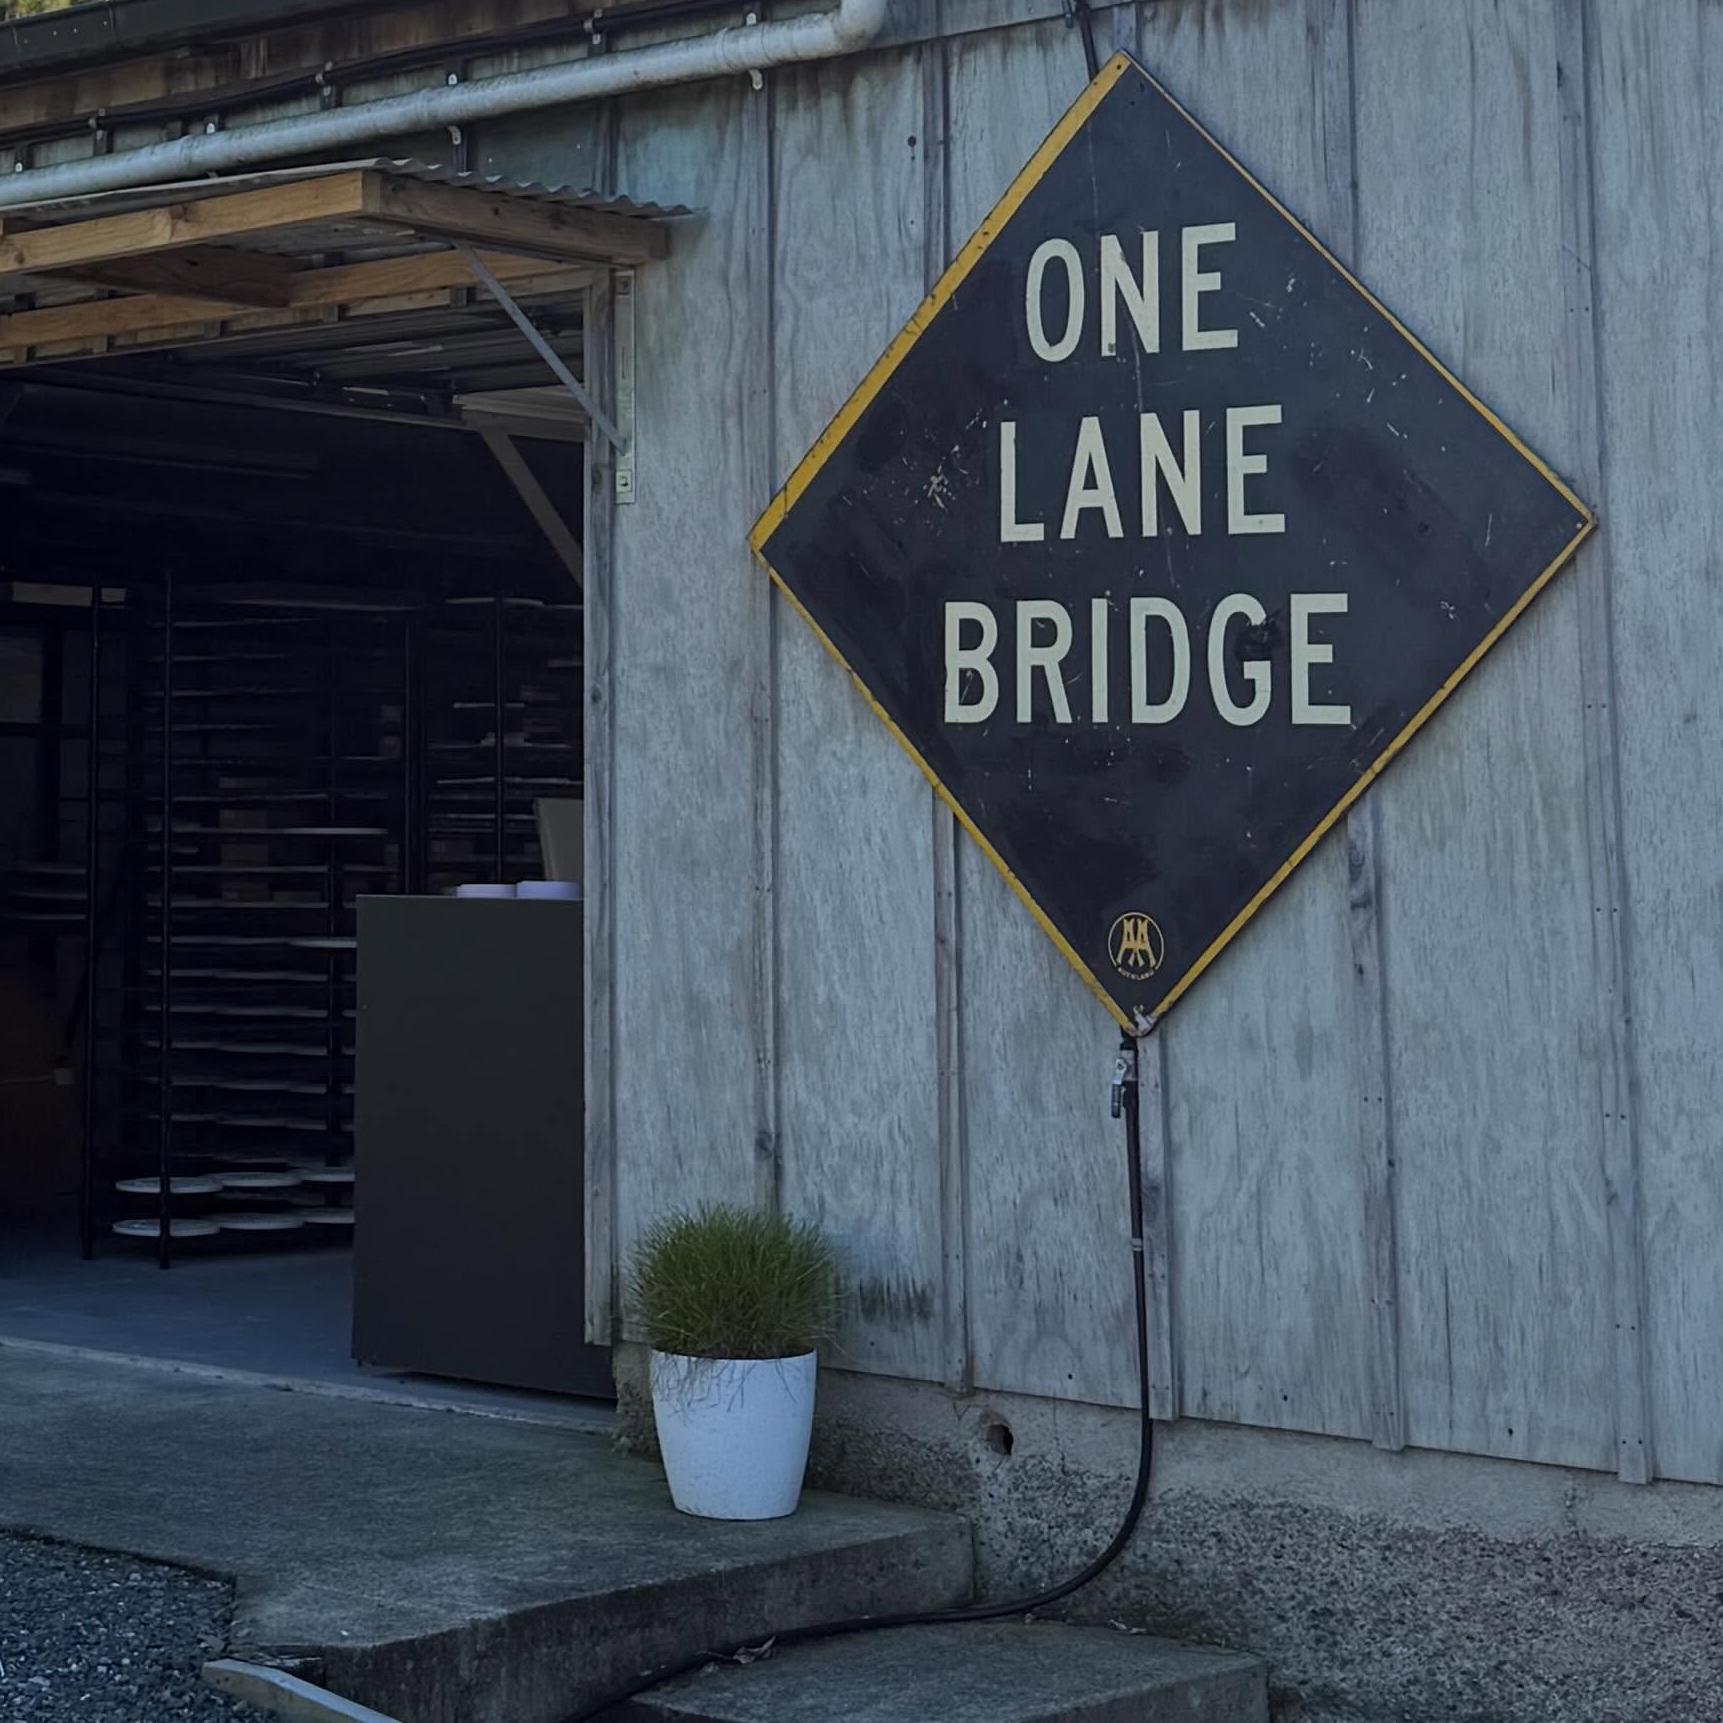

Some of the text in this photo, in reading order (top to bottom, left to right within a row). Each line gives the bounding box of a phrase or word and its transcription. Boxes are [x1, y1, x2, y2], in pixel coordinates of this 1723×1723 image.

[1026, 222, 1238, 362] ONE
[1000, 405, 1285, 542] LANE
[944, 593, 1351, 726] BRIDGE
